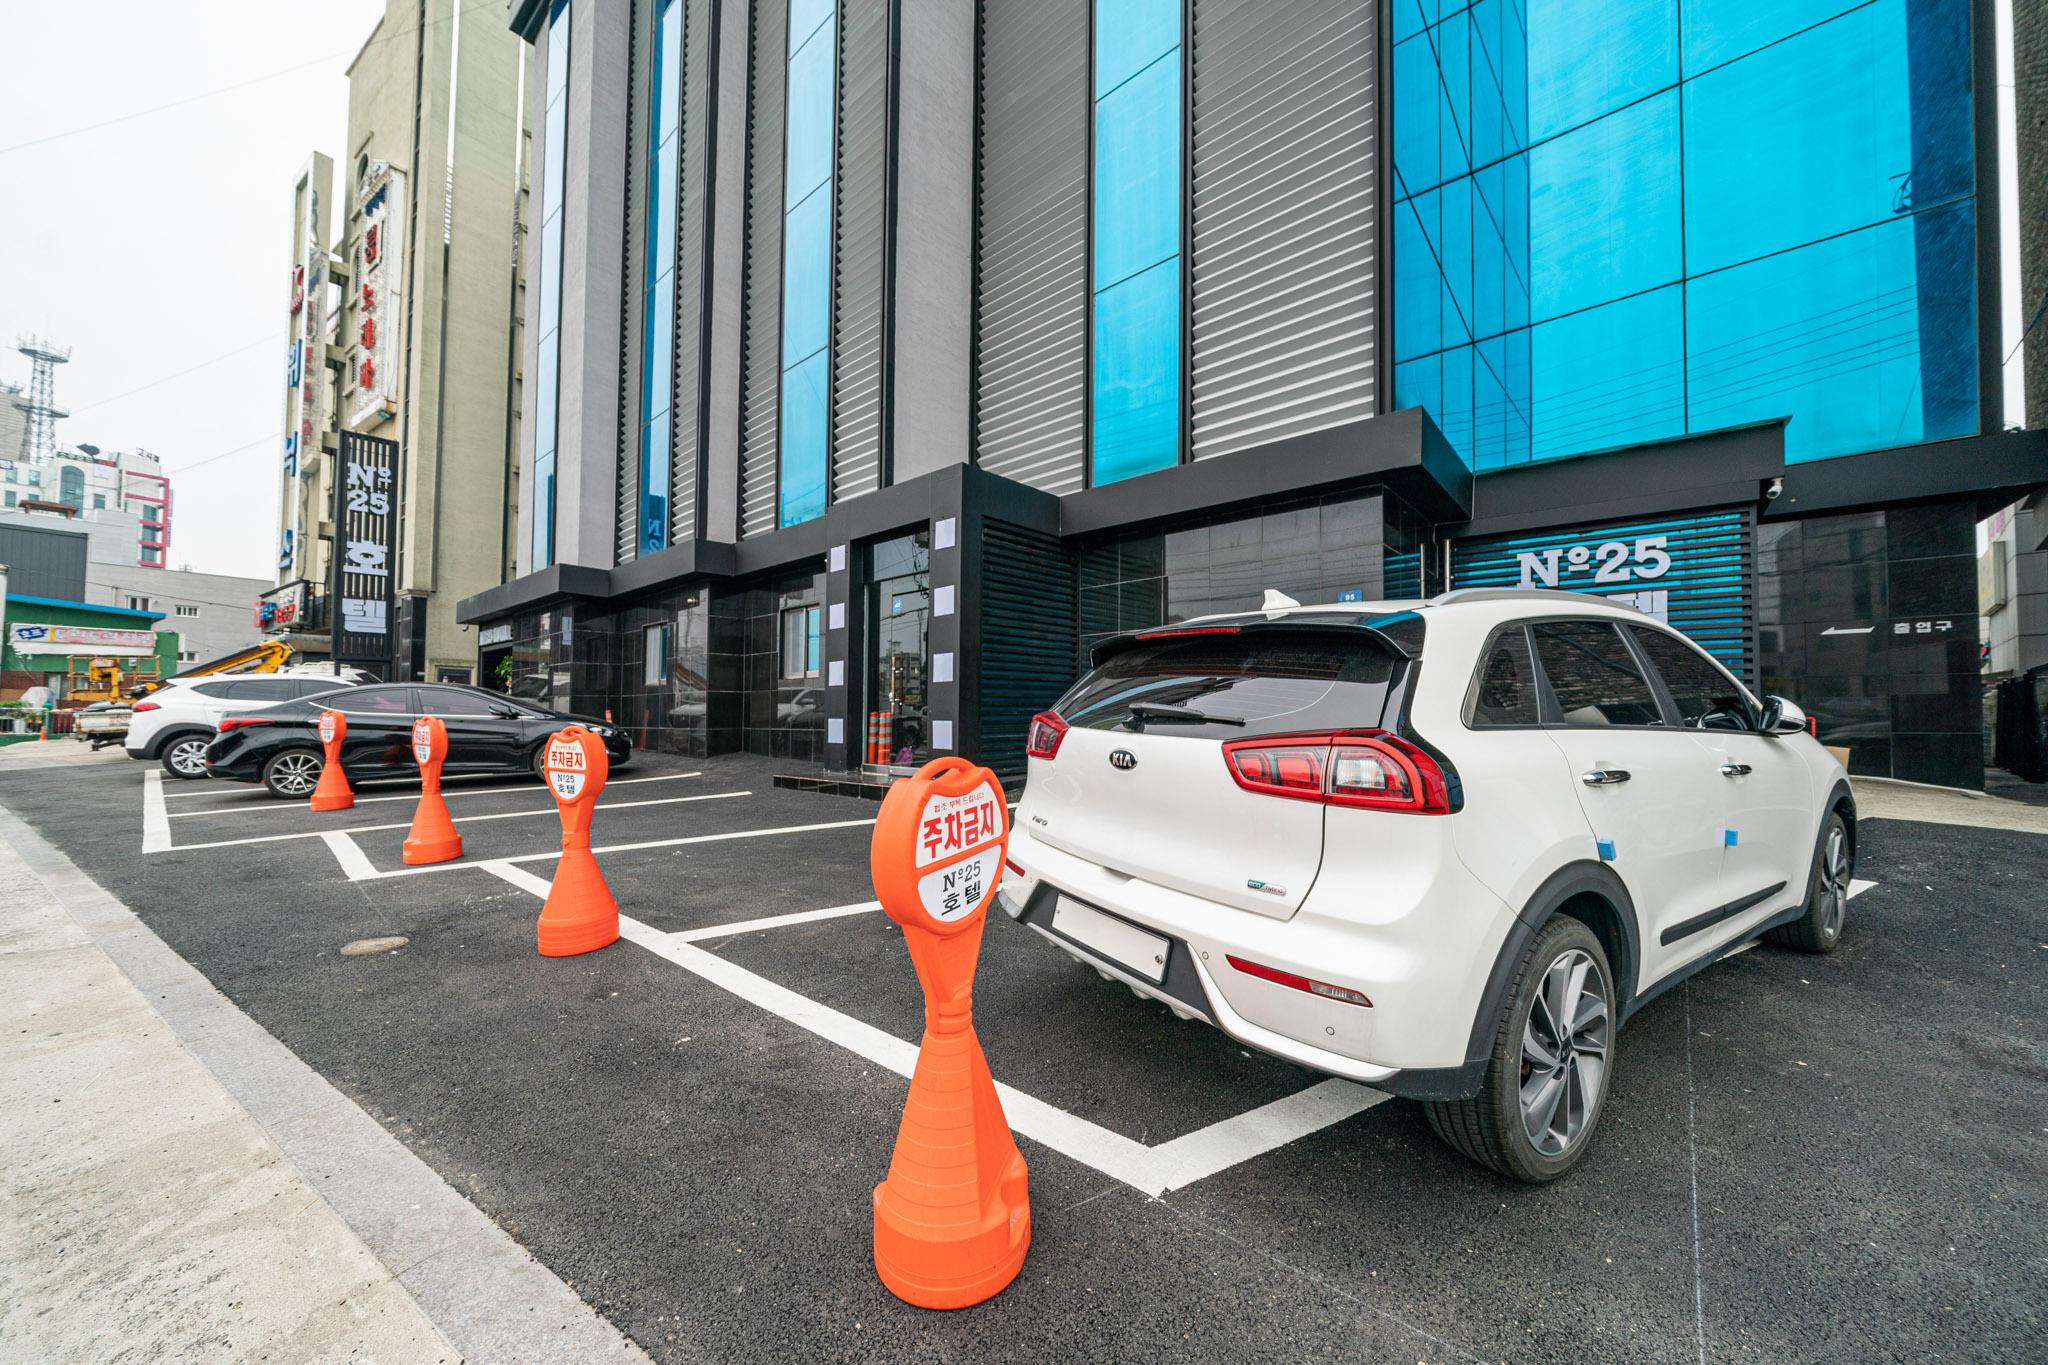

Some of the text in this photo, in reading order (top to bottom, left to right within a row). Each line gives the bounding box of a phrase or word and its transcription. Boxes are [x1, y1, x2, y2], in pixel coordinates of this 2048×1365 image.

[346, 490, 390, 516] 25
[342, 540, 389, 634] 호텔
[1893, 620, 1953, 634] 출입구
[551, 751, 583, 768] 주차금지
[1110, 753, 1133, 768] KIA
[933, 802, 948, 813] 협조
[962, 792, 985, 805] 드립니다
[923, 800, 995, 859] 주차금지
[941, 880, 982, 916] 호텔
